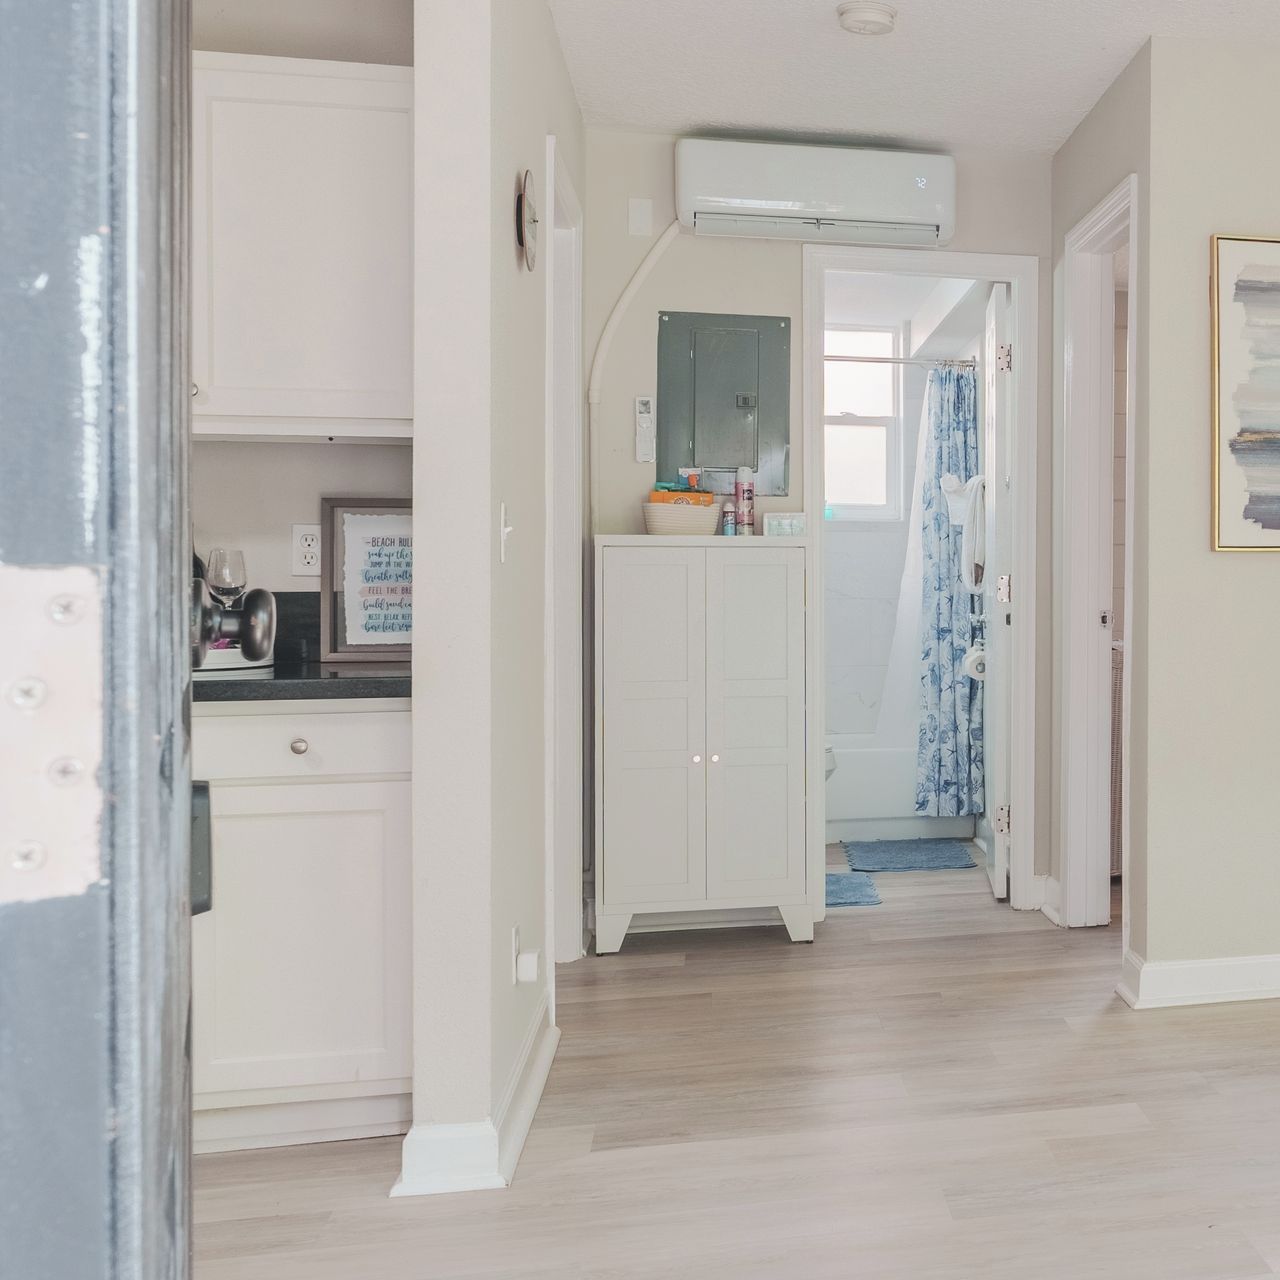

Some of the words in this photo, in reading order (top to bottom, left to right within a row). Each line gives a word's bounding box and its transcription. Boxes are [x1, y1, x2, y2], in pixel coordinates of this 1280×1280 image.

[371, 536, 395, 548] BEACH
[364, 569, 391, 583] breathe
[368, 586, 382, 595] FEEL
[386, 586, 398, 595] THE
[368, 613, 381, 621] REST
